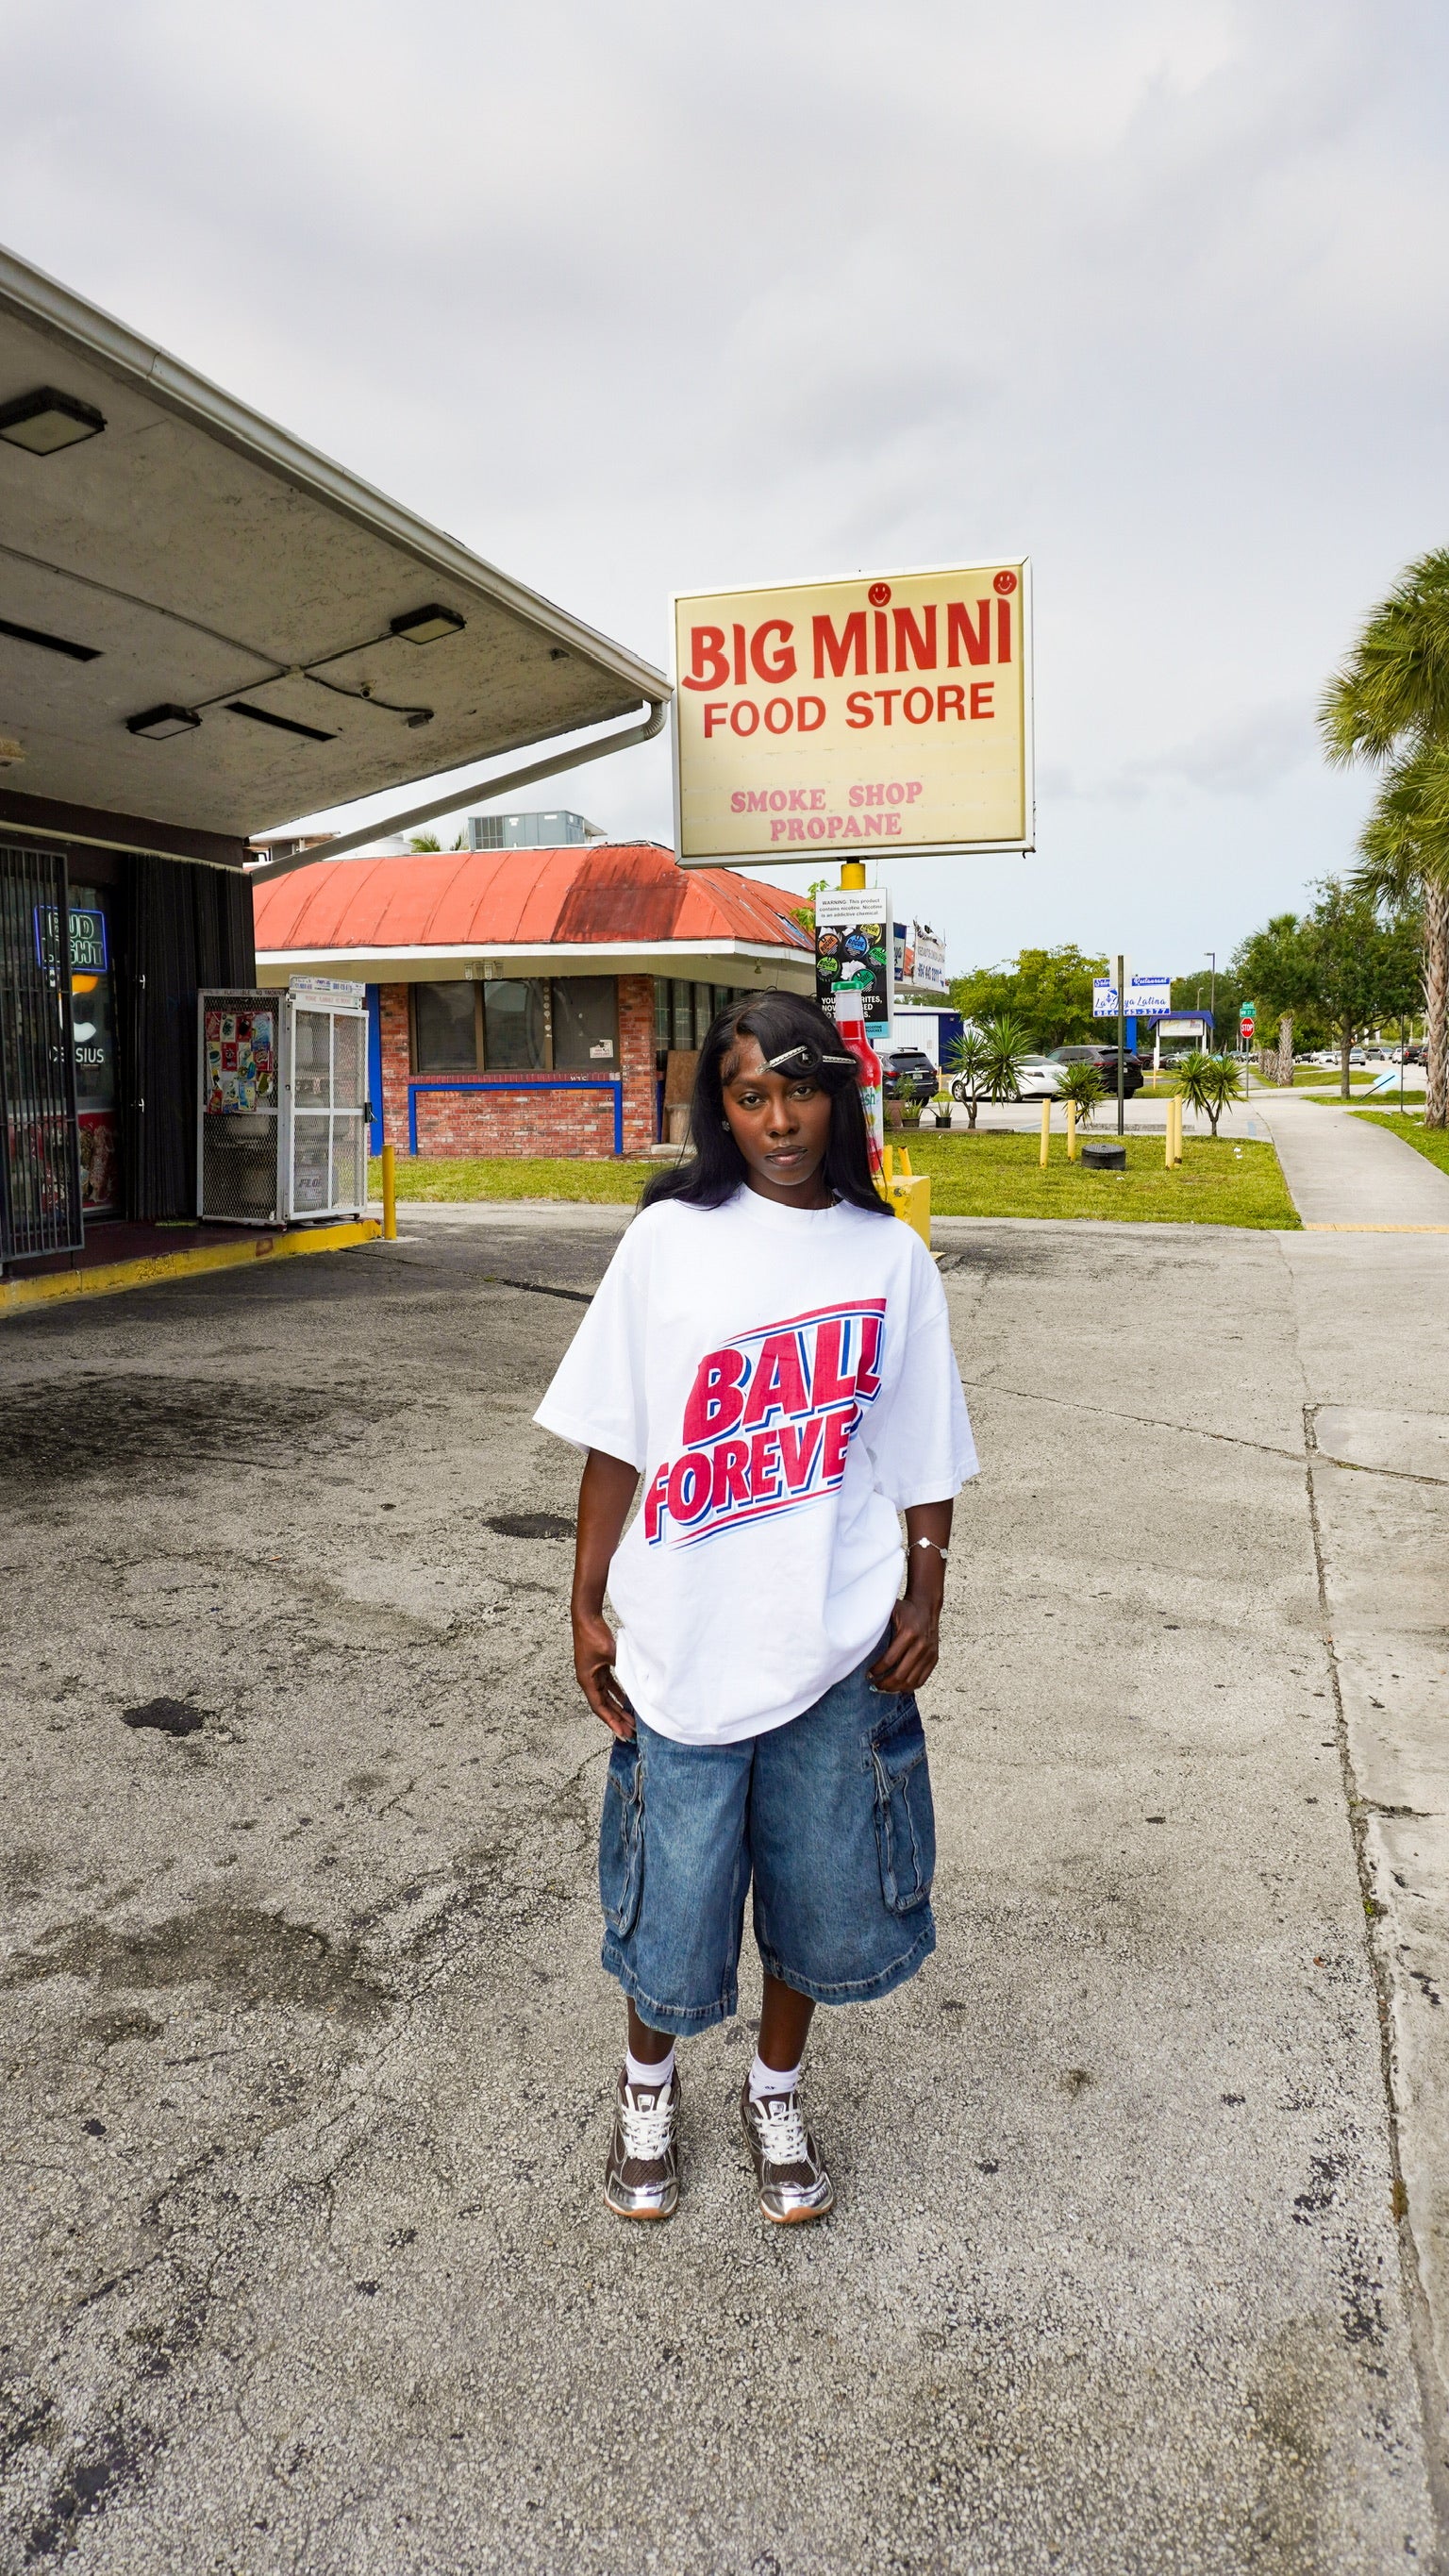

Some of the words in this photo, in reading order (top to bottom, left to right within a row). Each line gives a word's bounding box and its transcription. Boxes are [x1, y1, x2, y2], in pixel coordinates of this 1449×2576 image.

[681, 619, 798, 692] BIG
[704, 695, 826, 739] FOOD
[845, 681, 995, 728] STORE
[730, 788, 826, 813] SMOKE
[848, 781, 923, 808] SHOP
[770, 812, 902, 842] PROPANE
[820, 936, 835, 952] ROGUE
[848, 938, 865, 948] ROGUE
[819, 960, 837, 968] ROGUE
[821, 996, 836, 1005] YOU
[1094, 997, 1106, 1009] La
[1110, 995, 1135, 1010] Jya
[1137, 996, 1166, 1007] Latina
[1241, 1023, 1253, 1032] STOP
[49, 1045, 105, 1063] CSIUS
[682, 1317, 883, 1450] BALL
[644, 1403, 862, 1545] FOREVE
